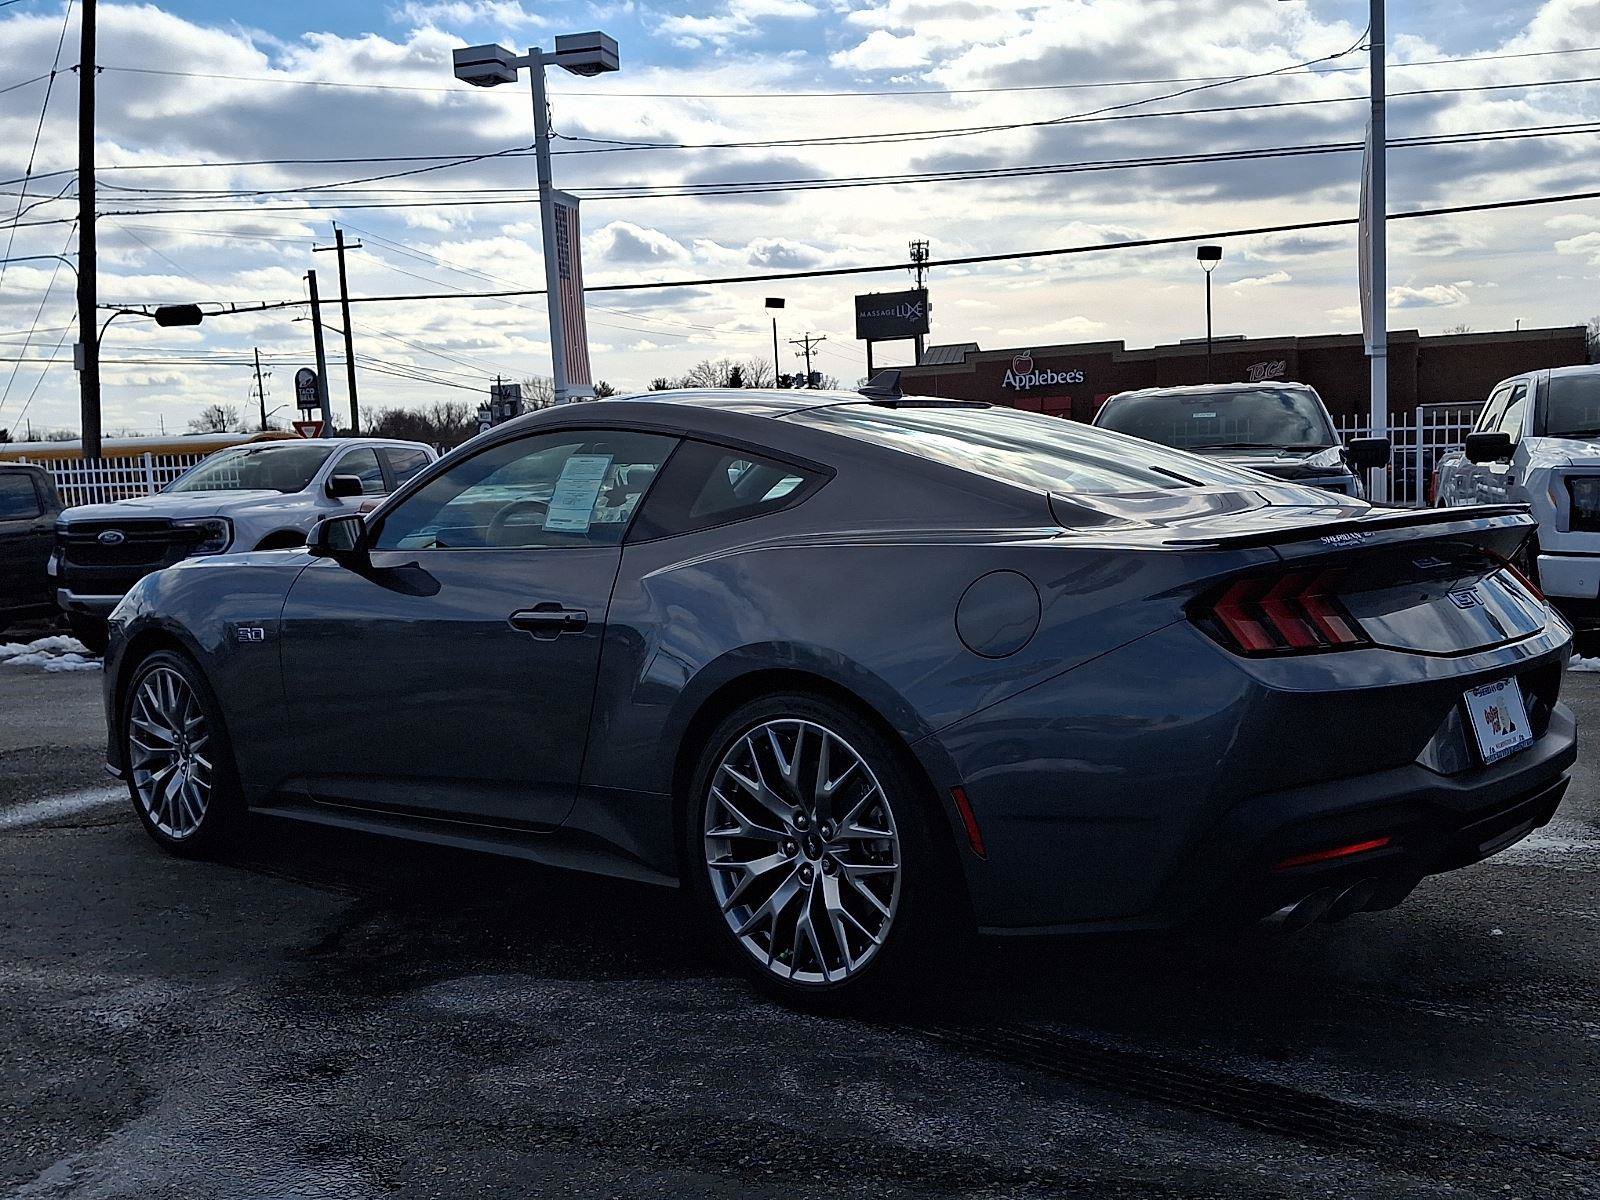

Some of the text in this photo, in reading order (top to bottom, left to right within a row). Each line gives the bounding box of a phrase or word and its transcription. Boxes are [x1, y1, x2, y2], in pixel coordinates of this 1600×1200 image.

[859, 308, 896, 318] MASSAGE
[1002, 369, 1084, 391] Applebee's
[1446, 586, 1485, 609] GT
